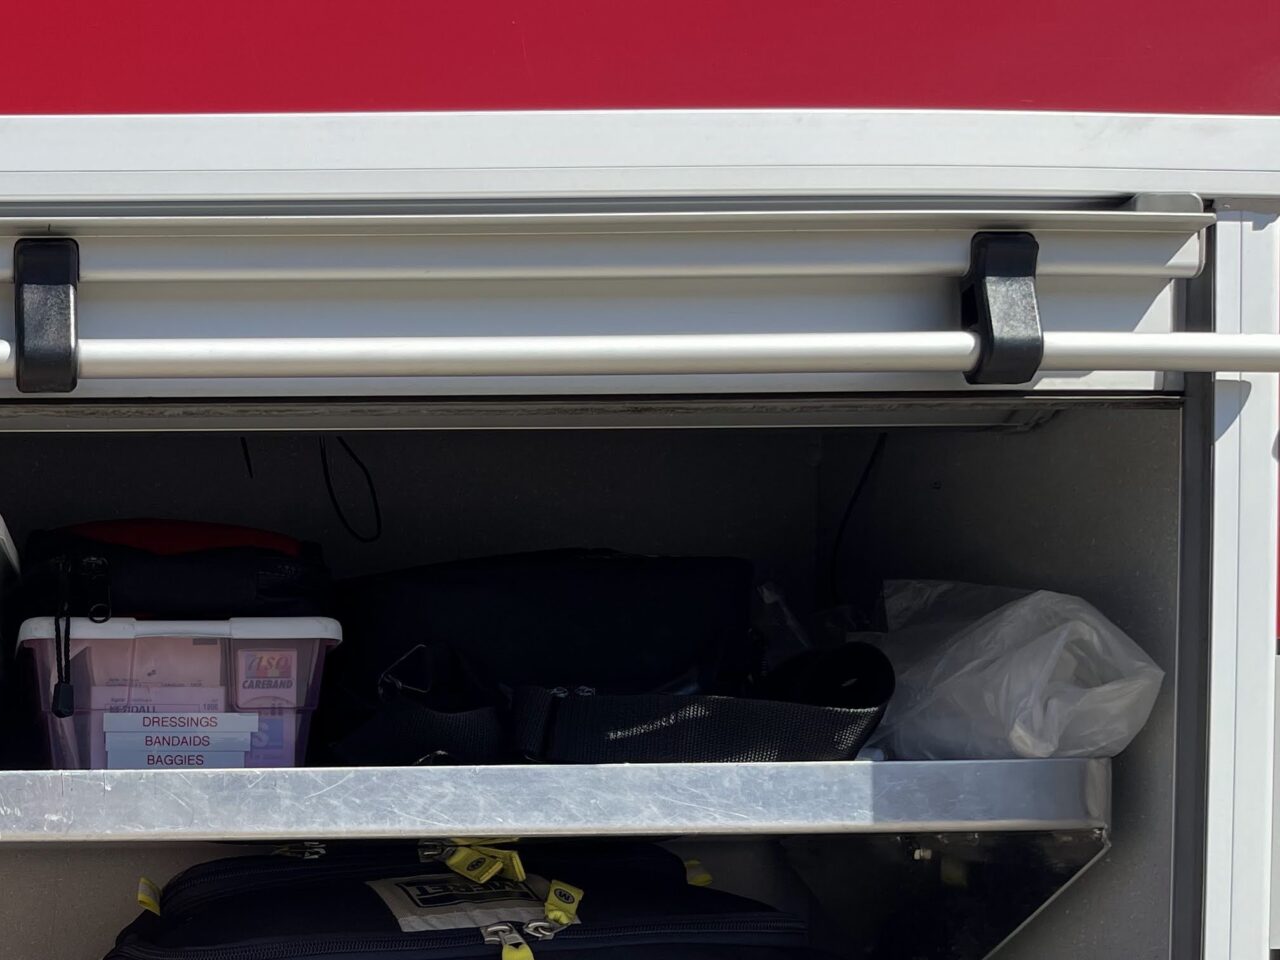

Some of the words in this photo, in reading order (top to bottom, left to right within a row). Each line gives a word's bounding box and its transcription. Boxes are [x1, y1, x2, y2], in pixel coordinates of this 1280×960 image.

[242, 679, 293, 690] CAREBAND
[142, 716, 218, 728] DRESSINGS
[145, 735, 210, 747] BANDAIDS
[146, 754, 204, 766] BAGGIES
